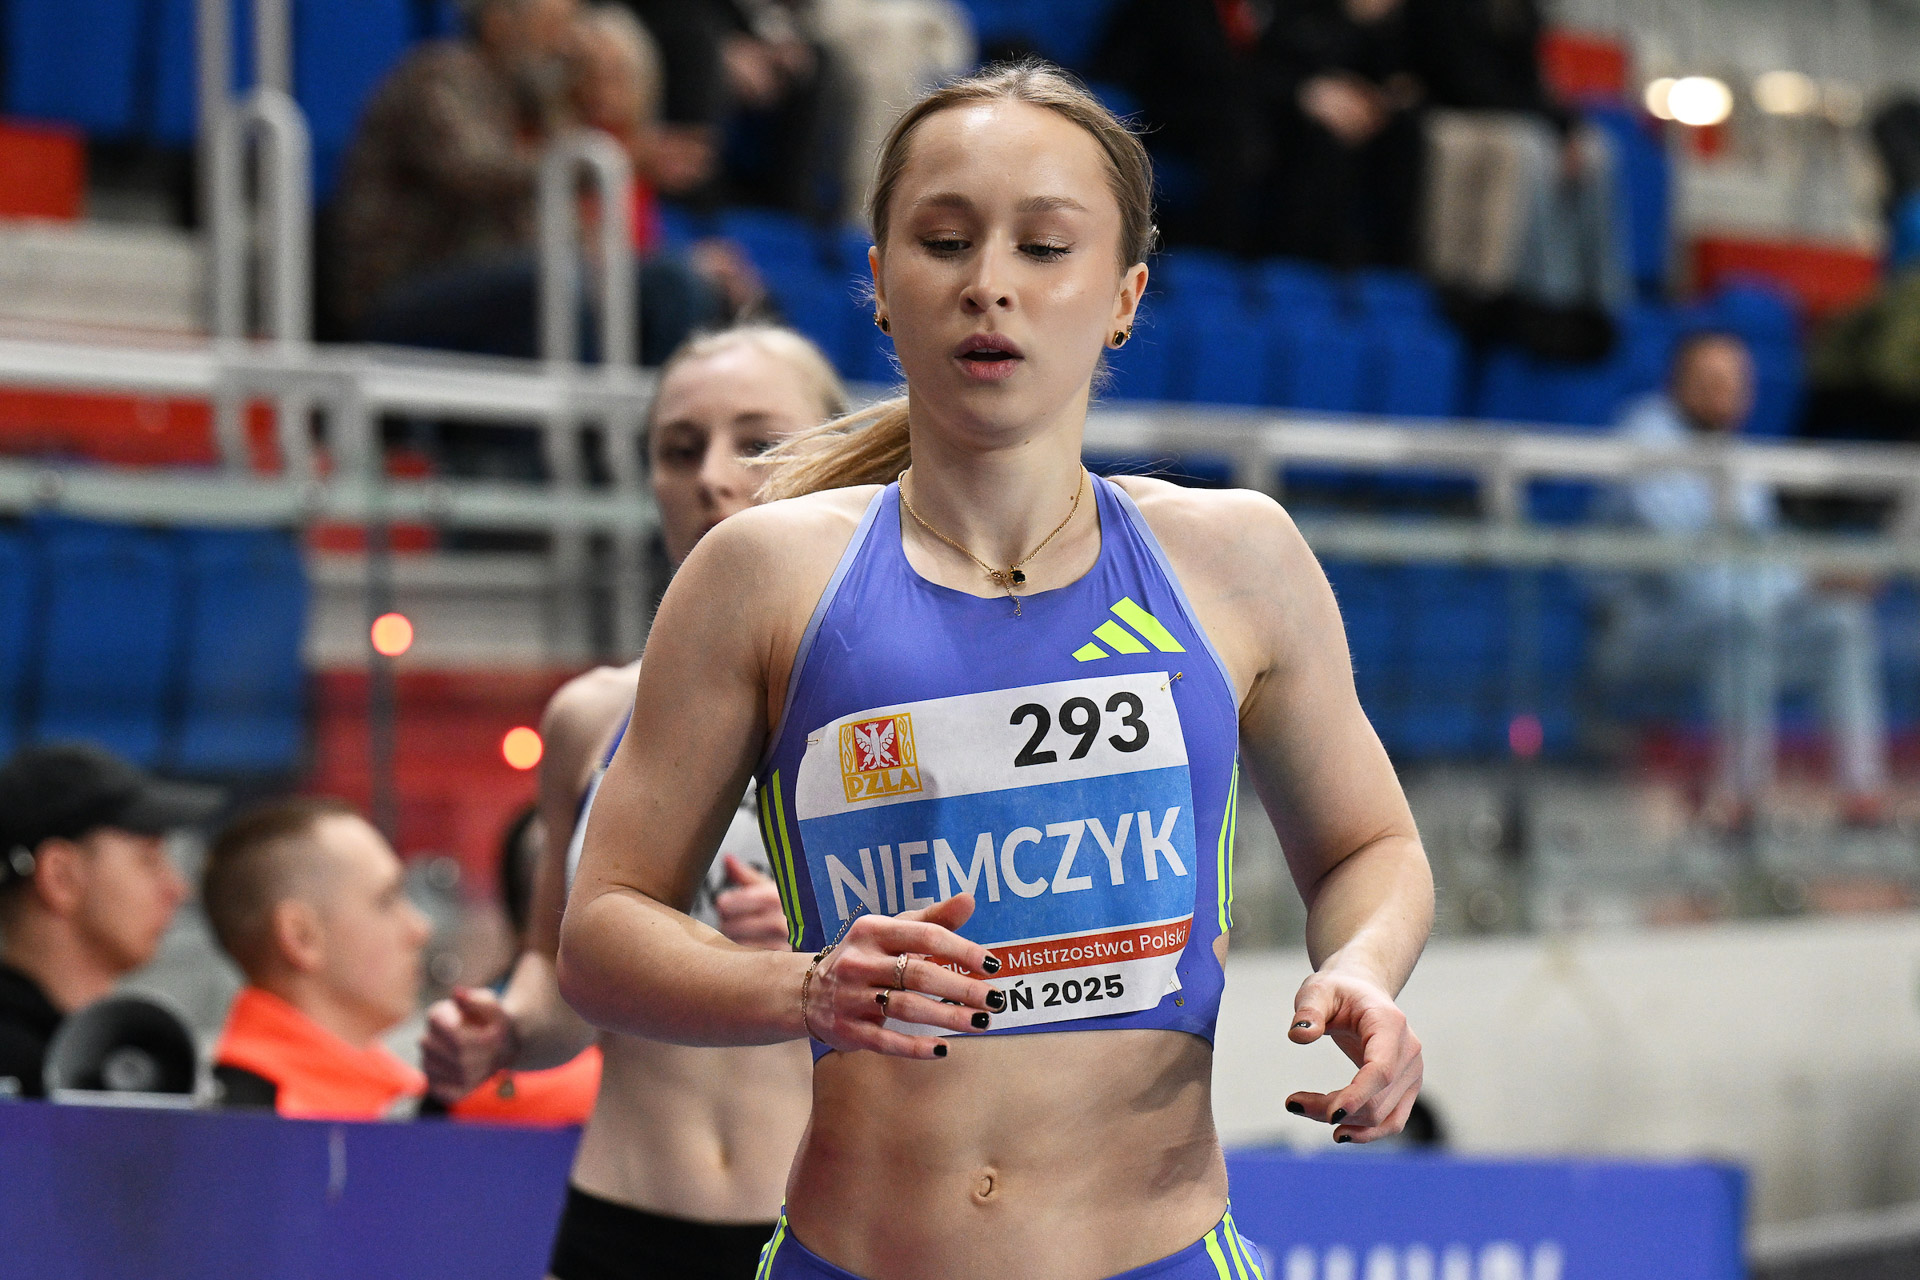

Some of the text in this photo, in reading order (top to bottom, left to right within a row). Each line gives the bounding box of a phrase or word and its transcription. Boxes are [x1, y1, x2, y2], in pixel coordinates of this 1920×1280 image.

[1009, 691, 1150, 768] 293
[847, 768, 918, 798] PZLA
[824, 806, 1188, 921] NIEMCZYK
[1008, 939, 1134, 969] Mistrzostwa
[1139, 925, 1186, 952] Polski
[1041, 974, 1124, 1007] 2025
